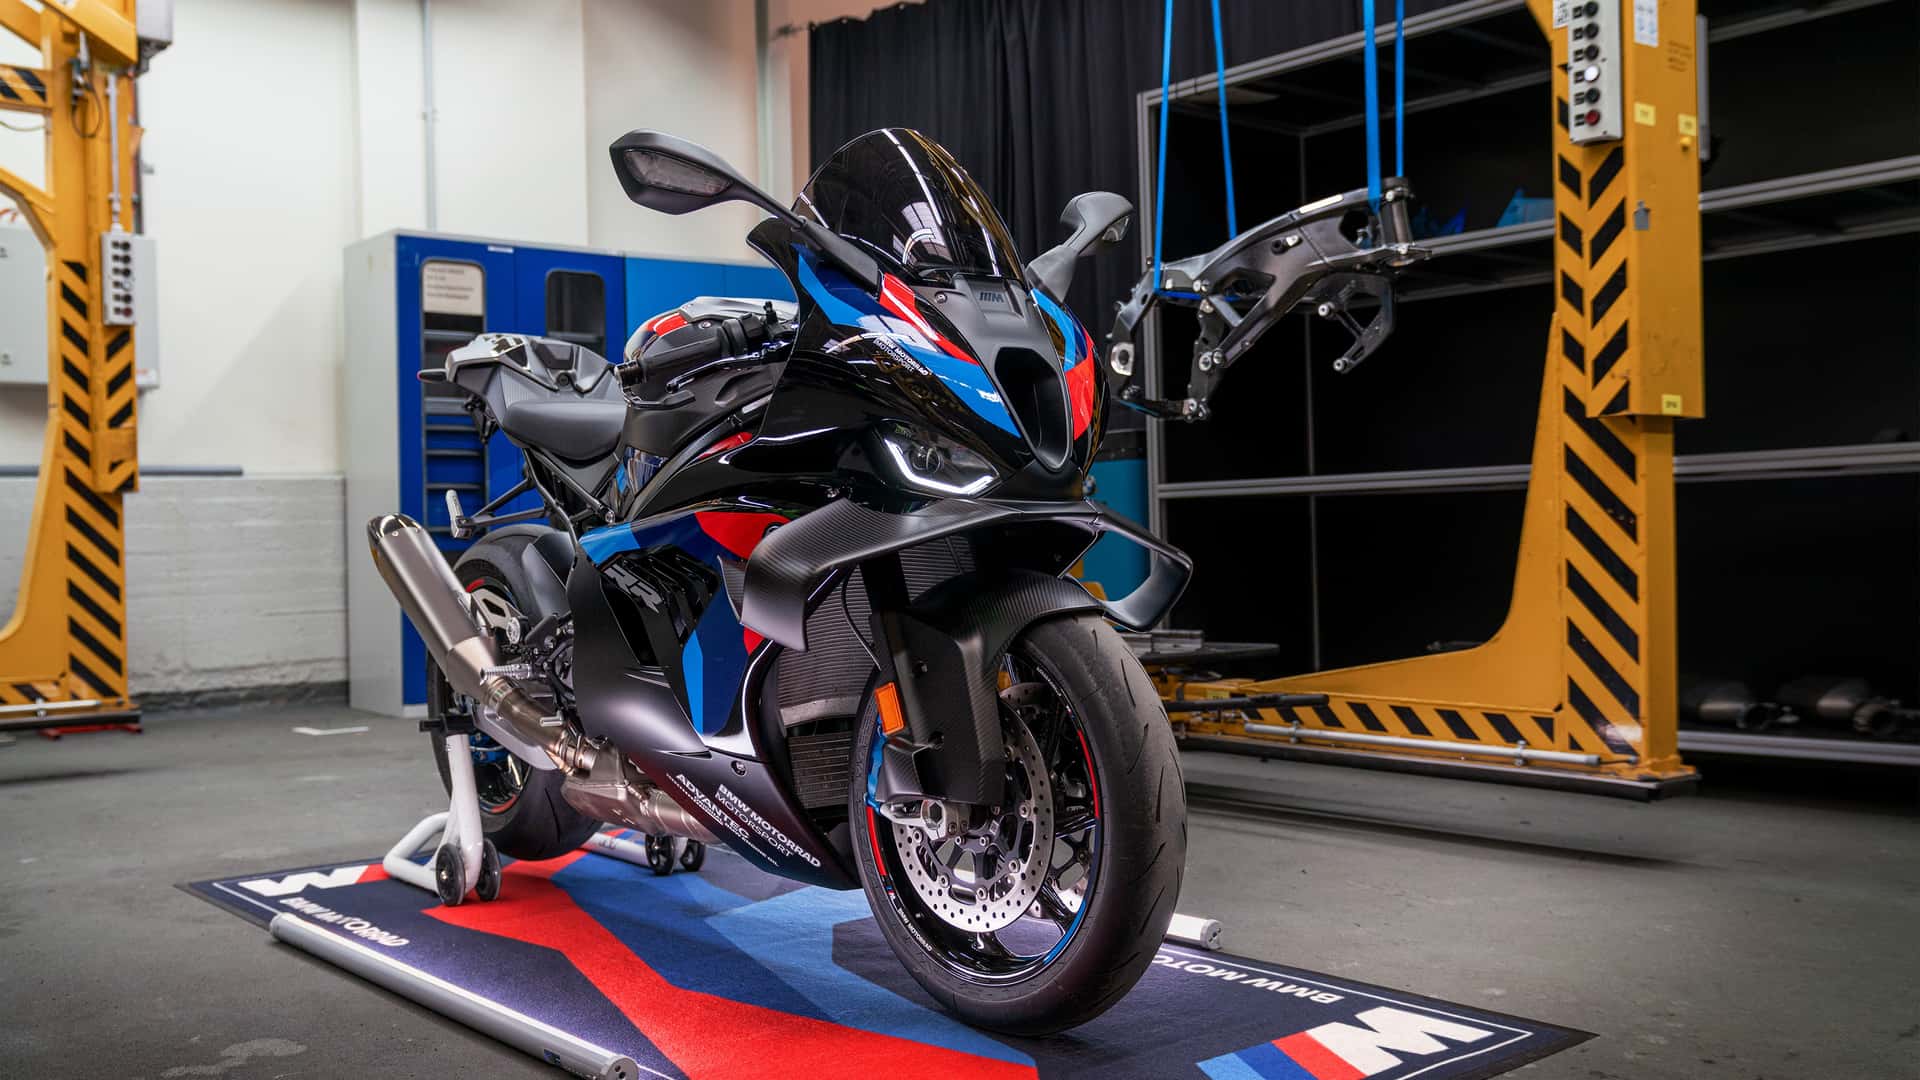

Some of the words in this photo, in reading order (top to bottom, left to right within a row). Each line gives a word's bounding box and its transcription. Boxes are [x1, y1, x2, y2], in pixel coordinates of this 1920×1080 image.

[675, 773, 750, 839] ADVANTEC
[714, 792, 794, 857] MOTORSPORT
[718, 784, 751, 813] BMW
[750, 810, 822, 868] MOTORRAD
[1240, 978, 1345, 1004] BMW
